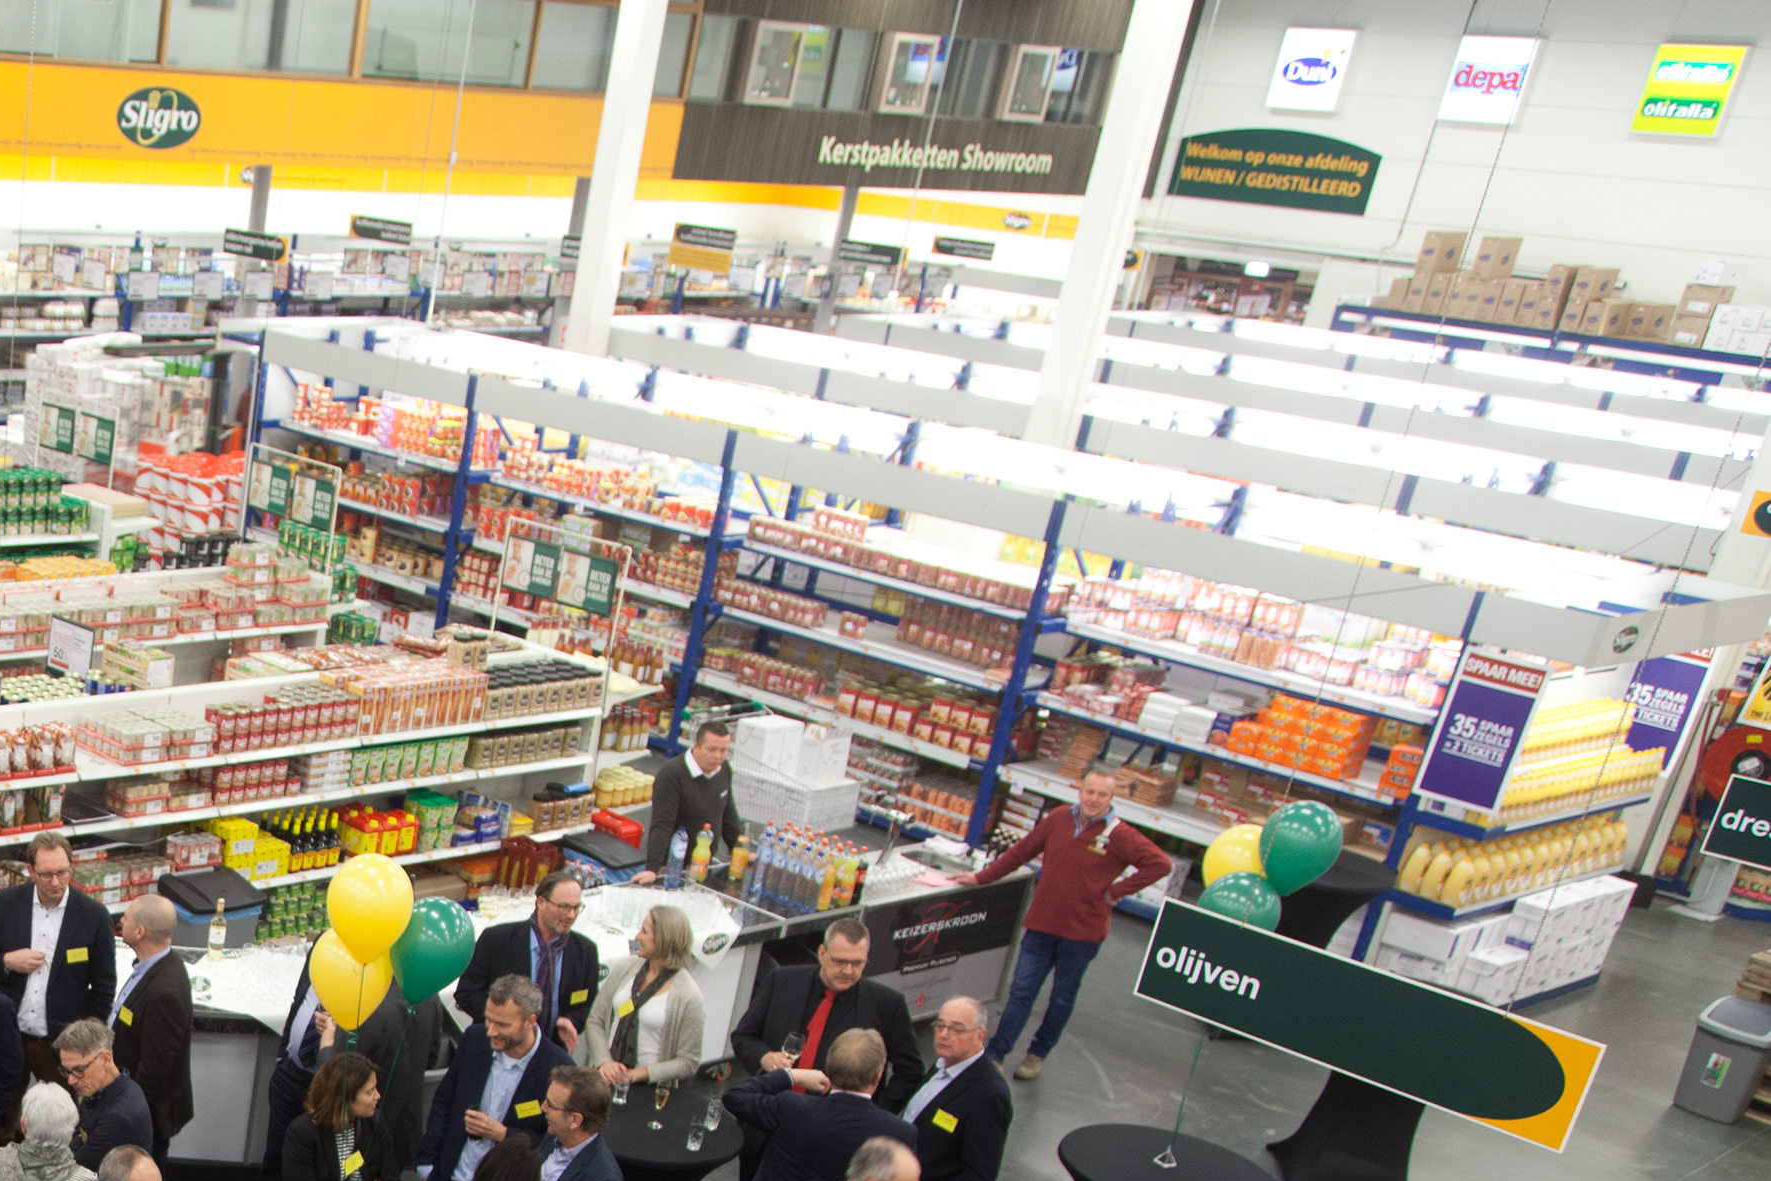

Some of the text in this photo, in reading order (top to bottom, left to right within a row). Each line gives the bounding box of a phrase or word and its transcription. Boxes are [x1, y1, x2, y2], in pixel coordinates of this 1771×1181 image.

[1286, 61, 1335, 83] Duni
[1455, 64, 1521, 94] depa
[120, 98, 199, 135] Sligro
[1642, 99, 1715, 119] olitalia
[818, 136, 1053, 174] Kerstpakketten Showroom
[1186, 141, 1369, 177] Welkom op onze afdeling
[1245, 171, 1362, 198] GEDISTILLEERD
[1464, 655, 1544, 691] SPAAR MEE!
[1625, 682, 1688, 705] 35 SPAAR
[1649, 698, 1685, 715] ZEGELS
[1447, 712, 1514, 738] 35 SPAAR
[1636, 709, 1679, 727] TICKETS
[1475, 728, 1512, 749] ZEGELS
[1461, 744, 1505, 764] TICKETS
[1720, 808, 1771, 838] dre
[892, 911, 987, 940] KEIZERSKROON
[1156, 945, 1261, 1000] olijven
